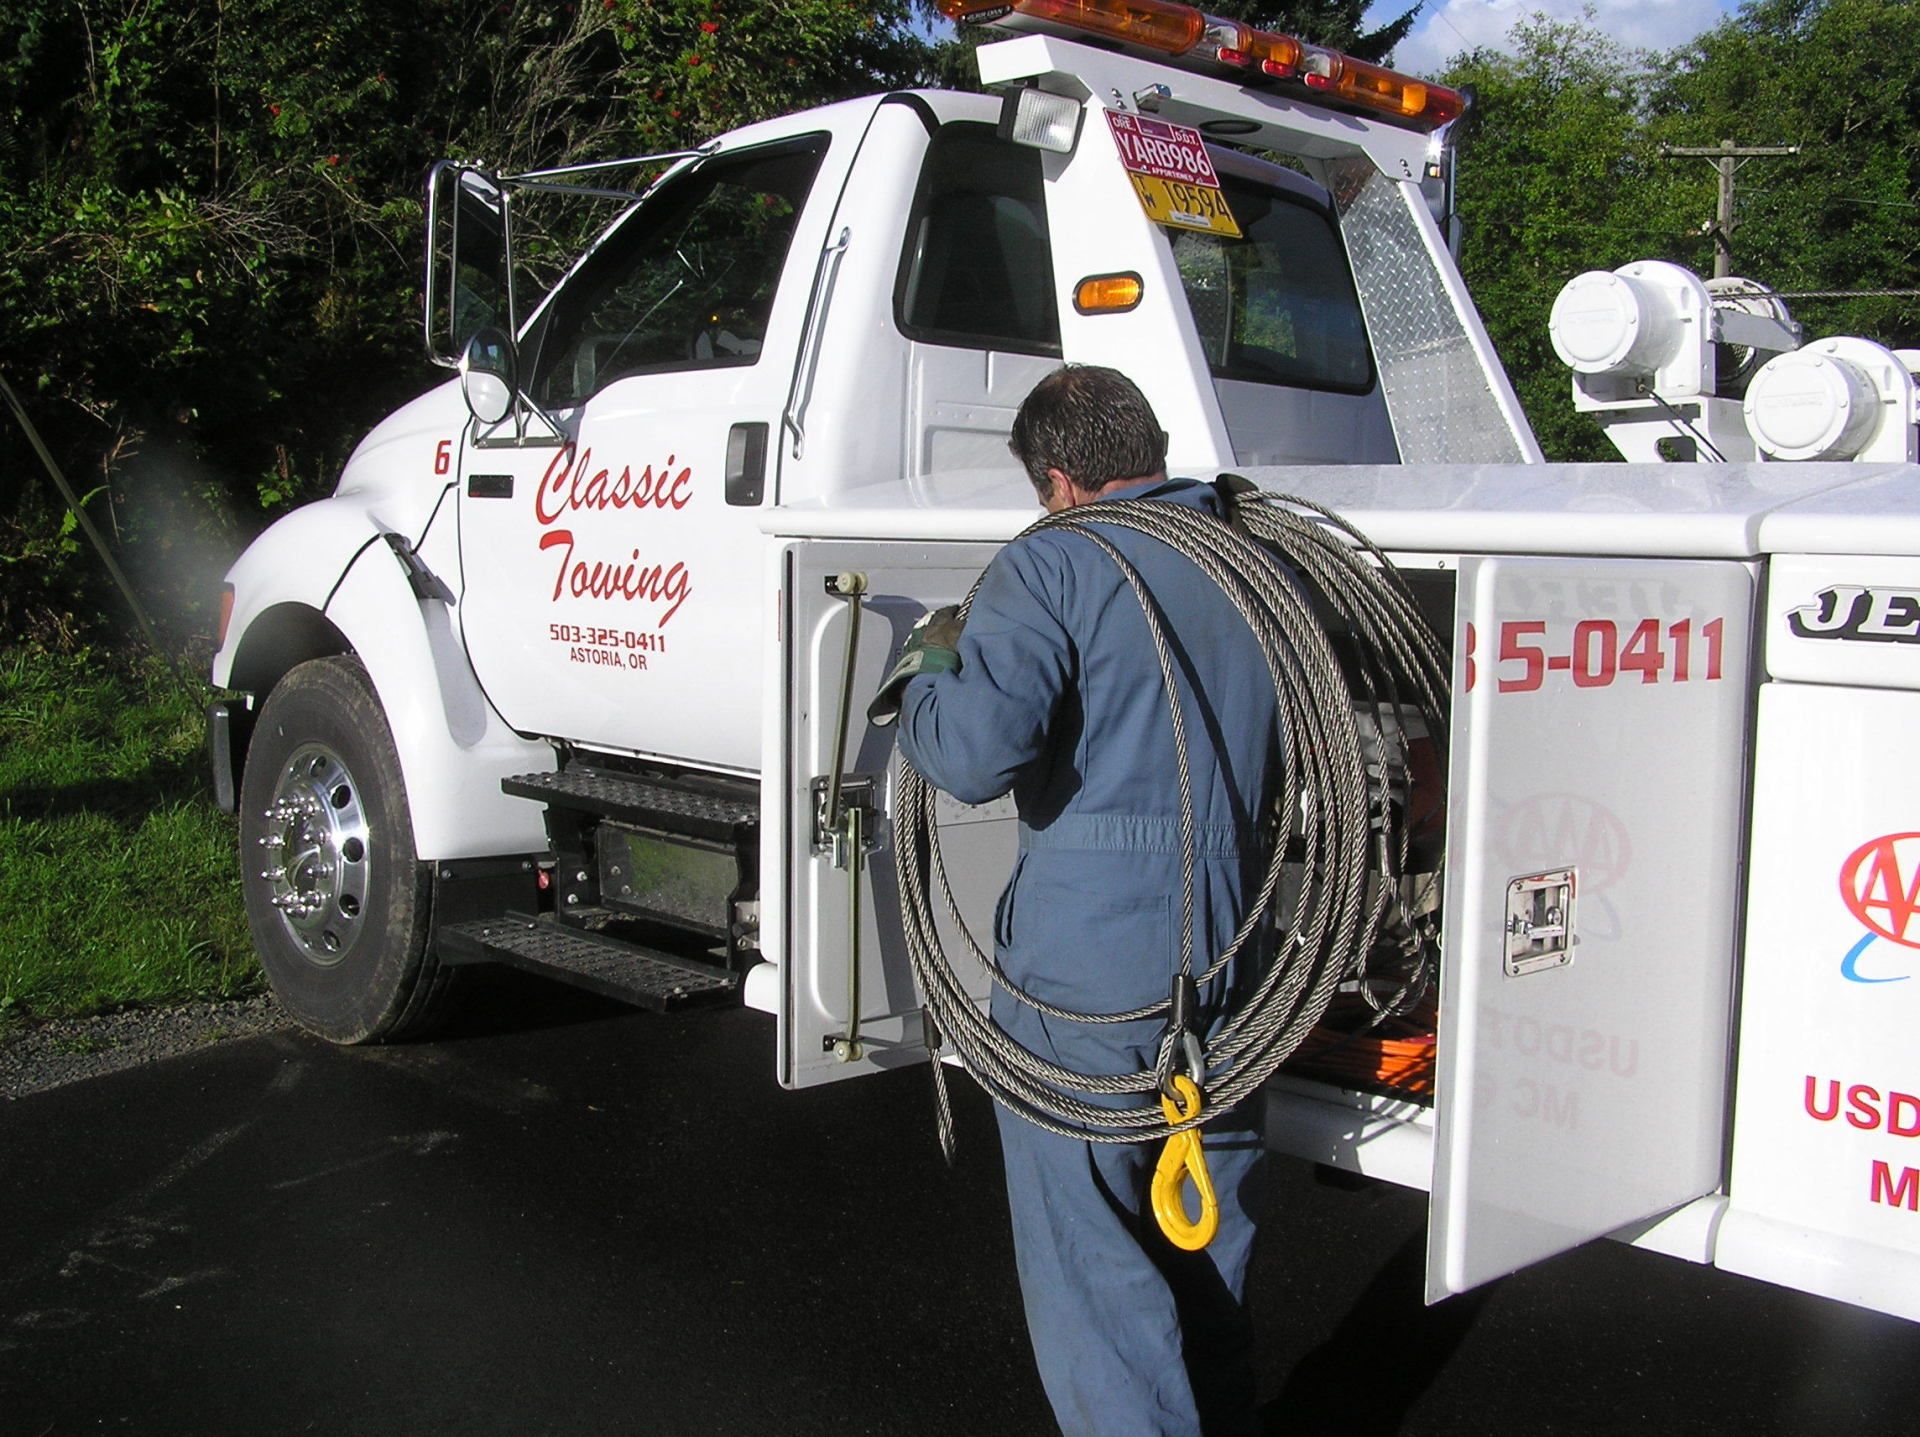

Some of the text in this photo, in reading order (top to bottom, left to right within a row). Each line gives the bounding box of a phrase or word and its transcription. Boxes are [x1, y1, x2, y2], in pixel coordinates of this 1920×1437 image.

[1115, 130, 1211, 177] YARB986
[1161, 180, 1232, 222] 19594
[434, 439, 452, 475] 6
[535, 441, 694, 526] Classic
[539, 529, 693, 629] Towing
[549, 623, 666, 653] 503-325-0411
[570, 646, 648, 671] ASTORIA, OR
